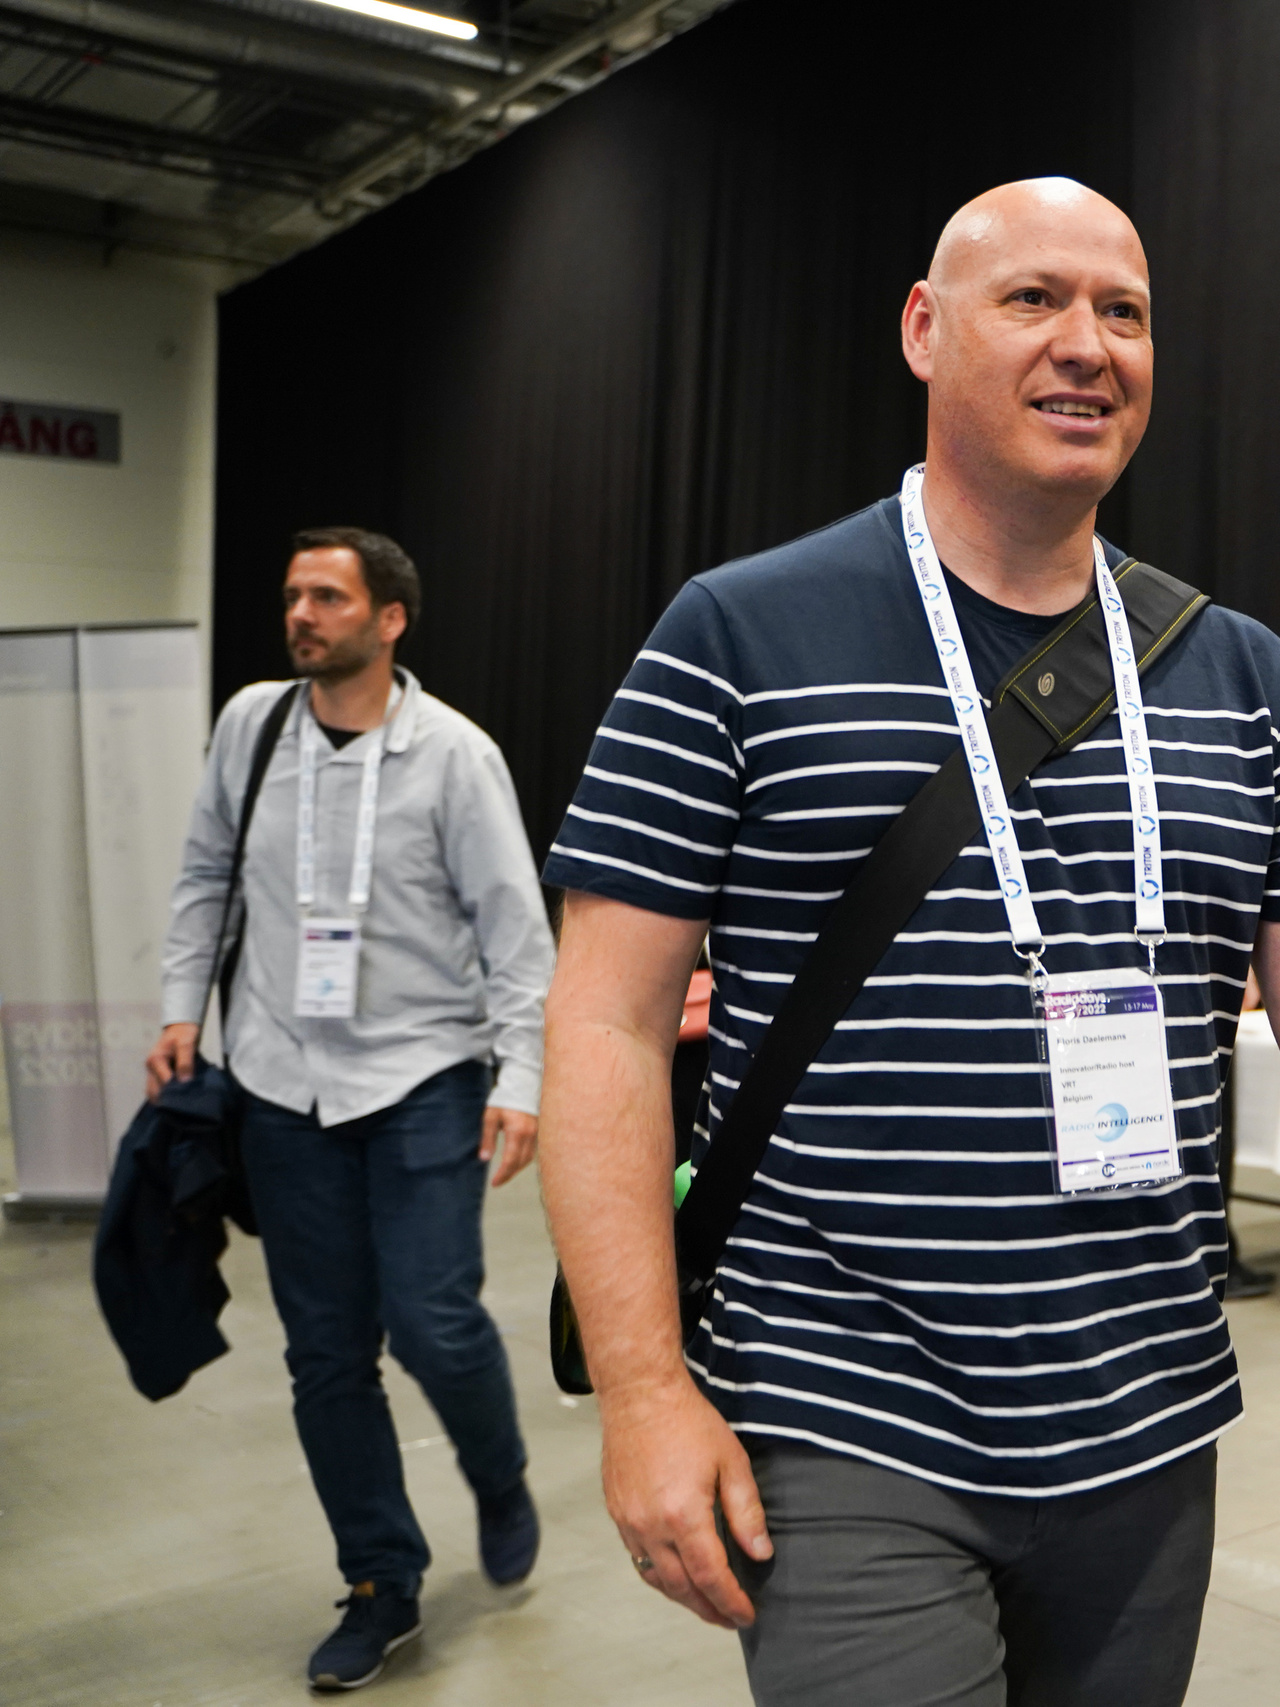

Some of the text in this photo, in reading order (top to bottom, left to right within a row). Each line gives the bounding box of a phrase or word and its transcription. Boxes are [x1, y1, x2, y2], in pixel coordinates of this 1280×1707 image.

[907, 510, 916, 532] TRITON
[916, 556, 931, 582] TRITON
[932, 610, 947, 636] TRITON
[1113, 620, 1124, 645] TRITON
[949, 666, 964, 693] TRITON
[1123, 672, 1133, 699] TRITON
[965, 723, 980, 752] TRITON
[1130, 728, 1140, 755] TRITON
[981, 784, 995, 813] TRITON
[1139, 785, 1148, 812] TRITON
[997, 846, 1012, 876] TRITON
[1083, 1034, 1127, 1044] Daelemans
[1119, 1061, 1135, 1069] host
[1062, 1081, 1076, 1089] VRT
[1063, 1095, 1093, 1104] Belgium
[1061, 1114, 1165, 1133] RADIO INTELLIGENCE
